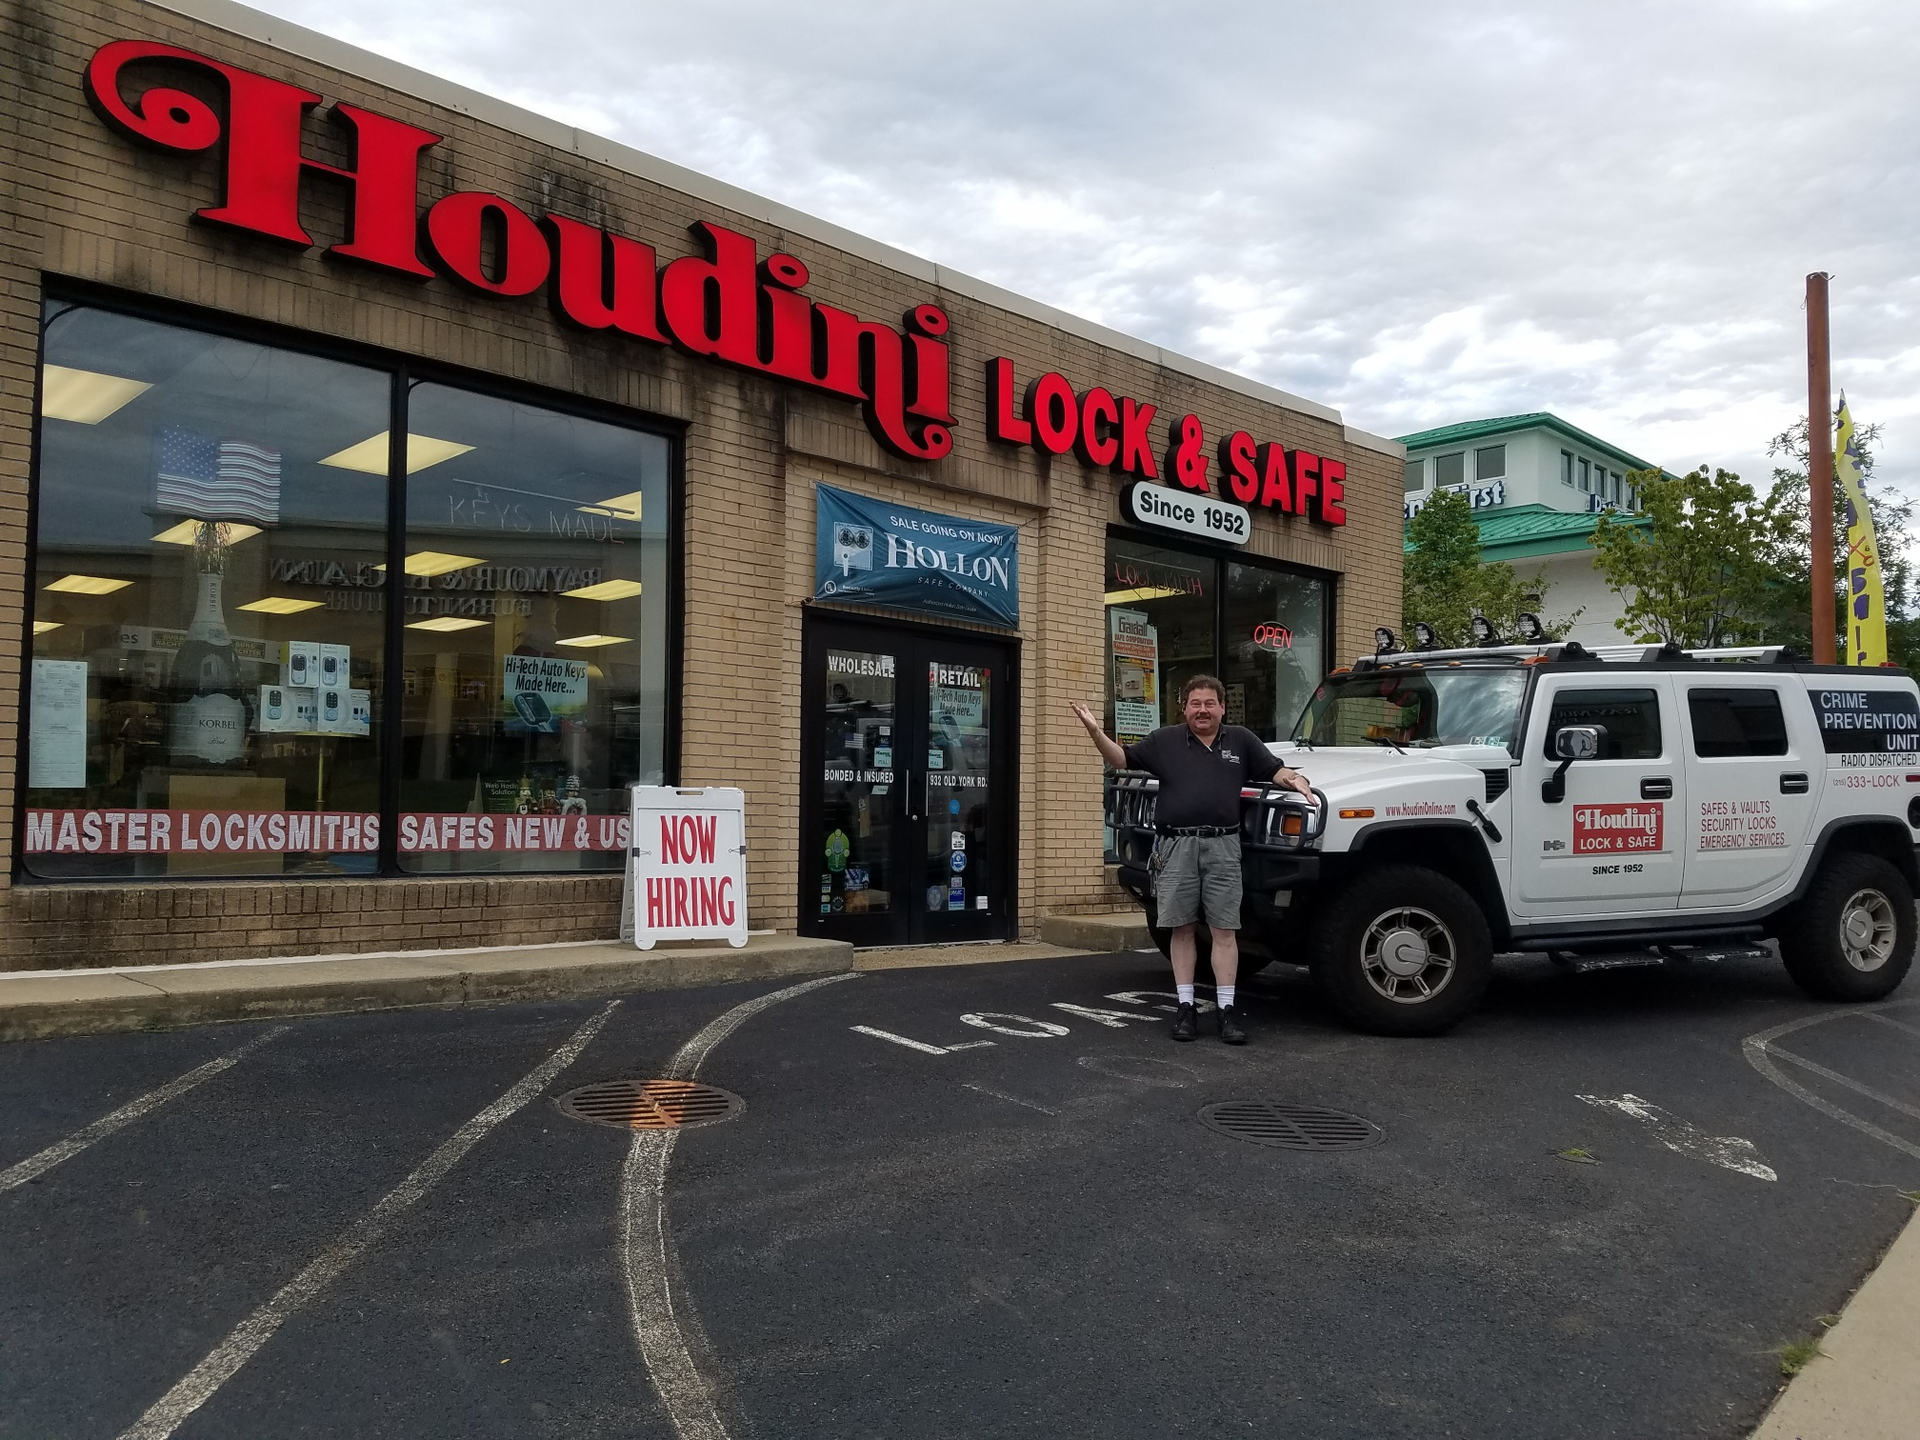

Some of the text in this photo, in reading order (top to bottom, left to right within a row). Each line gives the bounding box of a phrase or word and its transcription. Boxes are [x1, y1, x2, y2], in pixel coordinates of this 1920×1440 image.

[85, 40, 955, 462] Houdini
[988, 357, 1347, 525] LOCK & SAFE
[448, 491, 625, 544] KEYS MADE
[1139, 490, 1244, 537] Since 1952
[890, 516, 1003, 546] SALE GOING ON NOW!
[884, 532, 1010, 591] HOLLON
[917, 577, 990, 597] SAFE COMPANY
[1254, 625, 1293, 648] OPEN
[505, 657, 586, 682] Hi-Tech Auto Keys
[828, 655, 895, 678] WHOLESALE
[515, 675, 575, 694] Made Here...
[939, 670, 980, 687] RETAIL
[953, 691, 967, 704] Auto
[968, 693, 981, 705] Keys
[1820, 692, 1868, 708] CRIME
[939, 702, 955, 715] Made
[199, 719, 237, 729] KORBEL
[1824, 712, 1917, 729] PREVENTION
[1886, 734, 1920, 750] UNIT
[1841, 753, 1917, 767] RADIO DISPATCHED
[825, 769, 894, 784] BONDED & INSURED
[930, 775, 988, 788] 932 OLD YORK RD.
[1847, 775, 1900, 788] 333-LOCK
[1385, 802, 1457, 817] www.HoudiniOnline.com
[1701, 801, 1770, 816] SAFES & VAULTS
[1575, 807, 1658, 835] Houdini
[1701, 816, 1776, 832] SECURITY LOCKS
[26, 812, 380, 850] MASTER LOCKSMITHS
[401, 815, 493, 849] SAFES
[505, 817, 566, 849] NEW
[574, 817, 590, 849] &
[660, 815, 717, 864] NOW
[1701, 831, 1785, 849] EMERGENCY SERVICES
[1580, 836, 1656, 850] LOCK & SAFE
[1592, 863, 1643, 875] SINCE 1952
[646, 875, 735, 928] HIRING
